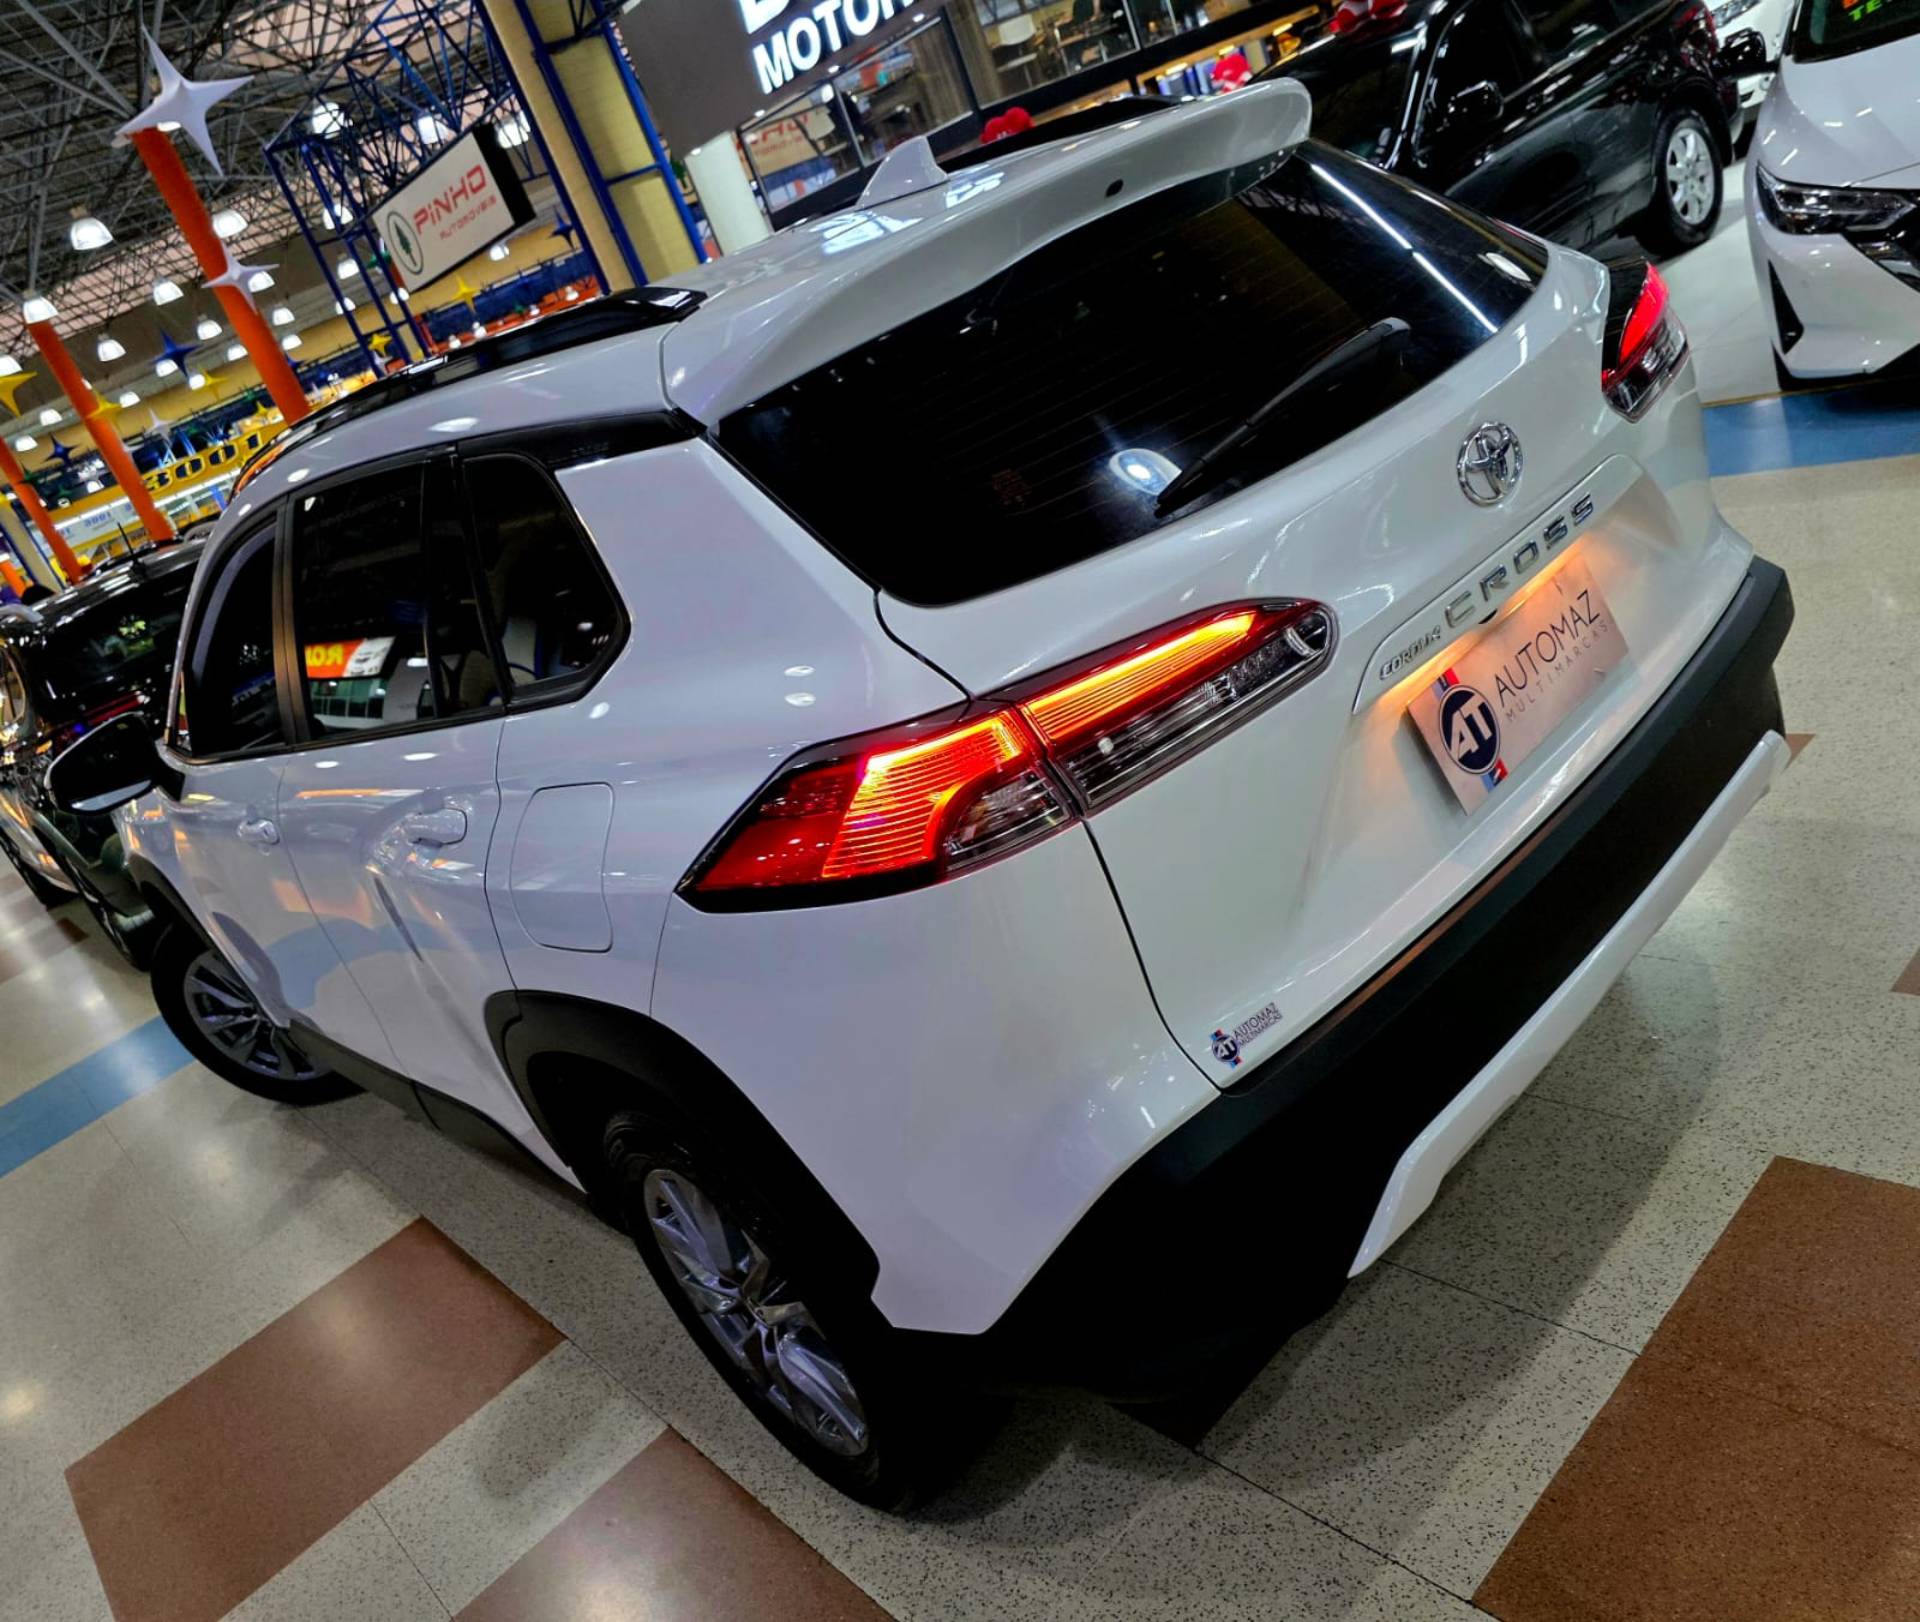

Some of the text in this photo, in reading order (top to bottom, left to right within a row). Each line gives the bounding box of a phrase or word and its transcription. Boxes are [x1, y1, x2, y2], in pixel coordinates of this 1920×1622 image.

[1444, 492, 1594, 628] CROSS
[1494, 589, 1600, 708] AUTOMAZ
[1505, 618, 1609, 722] MULTIMARCAS
[1232, 1002, 1279, 1041] AUTOMAZ
